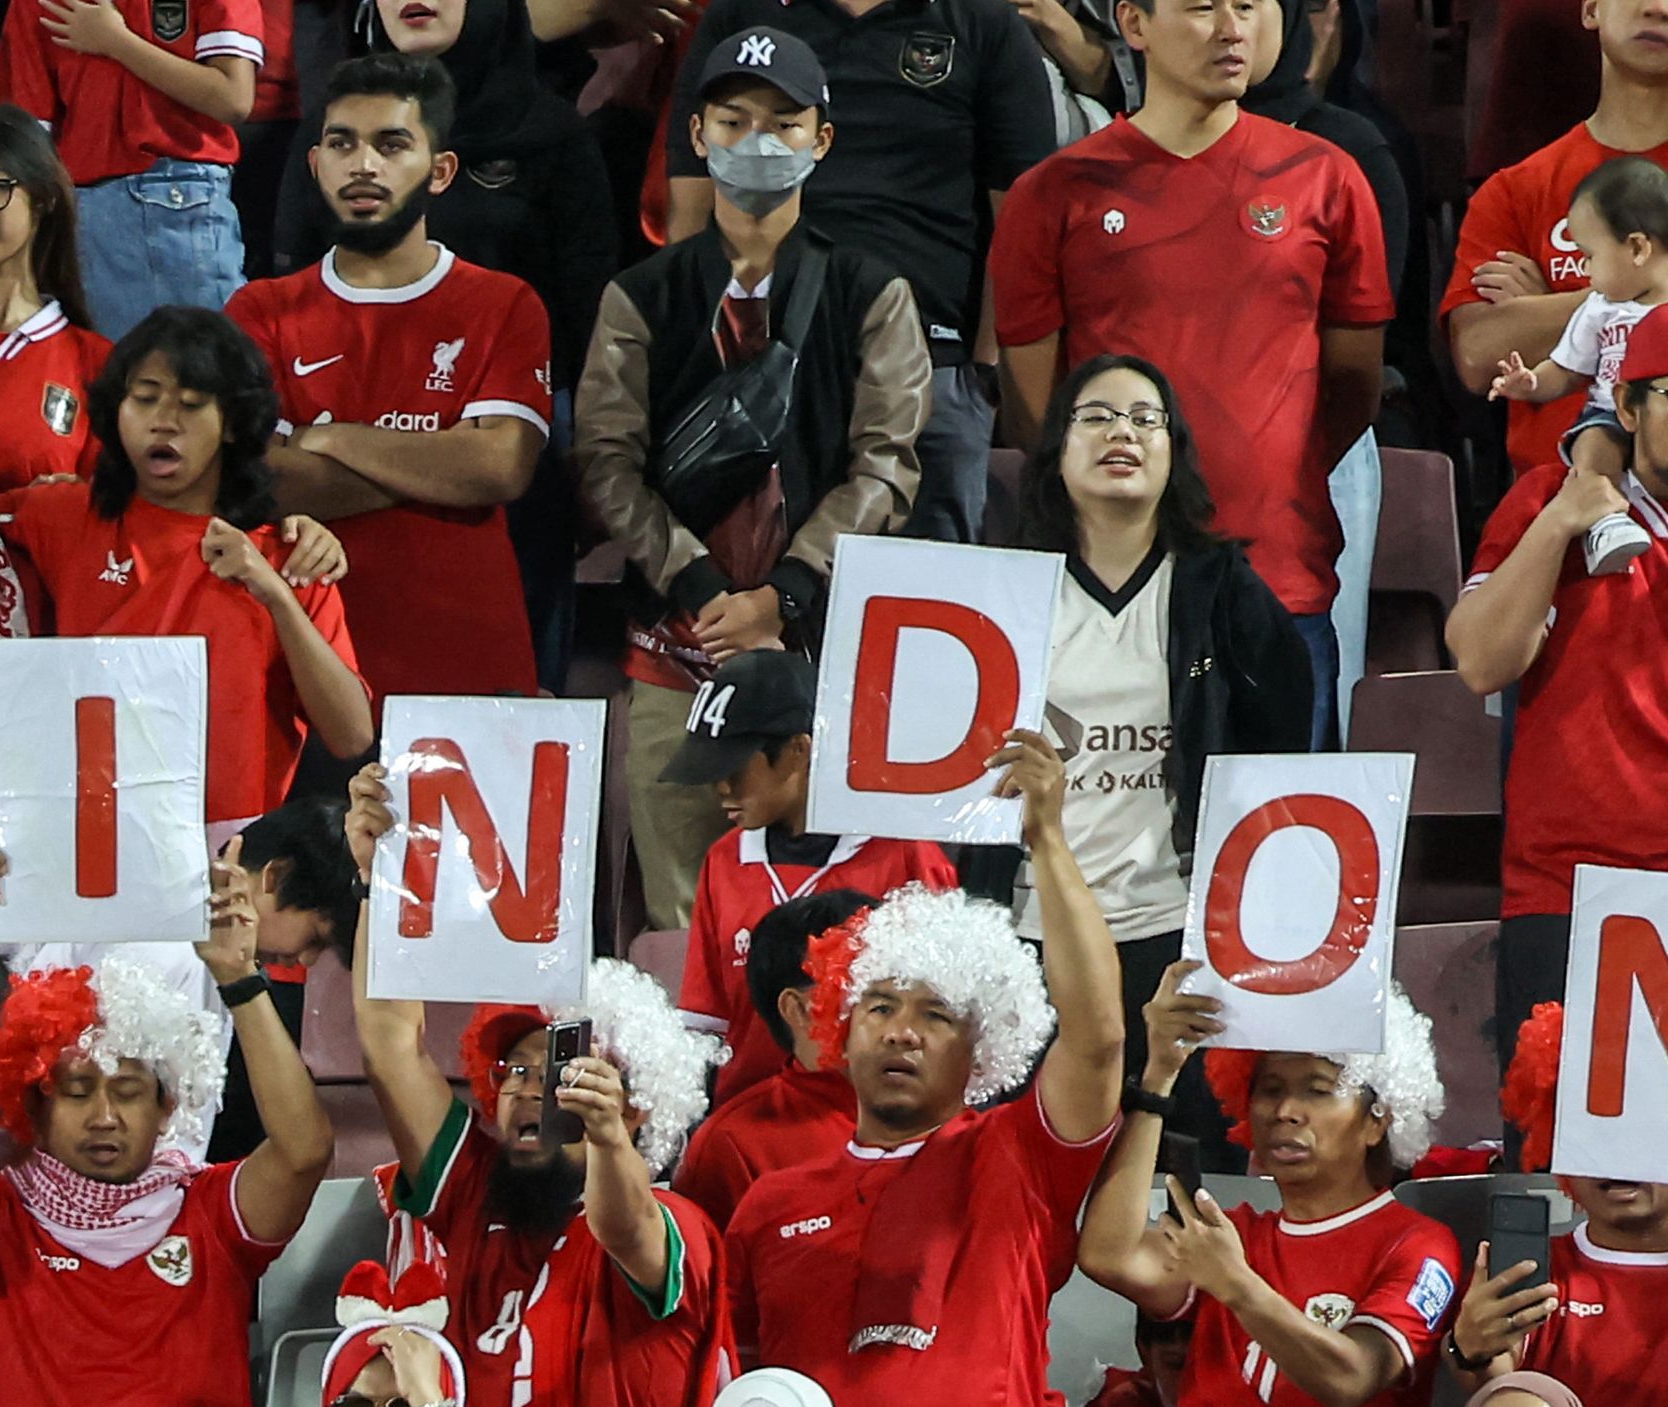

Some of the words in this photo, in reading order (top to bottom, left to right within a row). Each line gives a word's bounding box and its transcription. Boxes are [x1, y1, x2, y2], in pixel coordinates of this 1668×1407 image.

[736, 35, 776, 66] NY
[426, 377, 455, 393] LFC
[375, 410, 439, 432] dard
